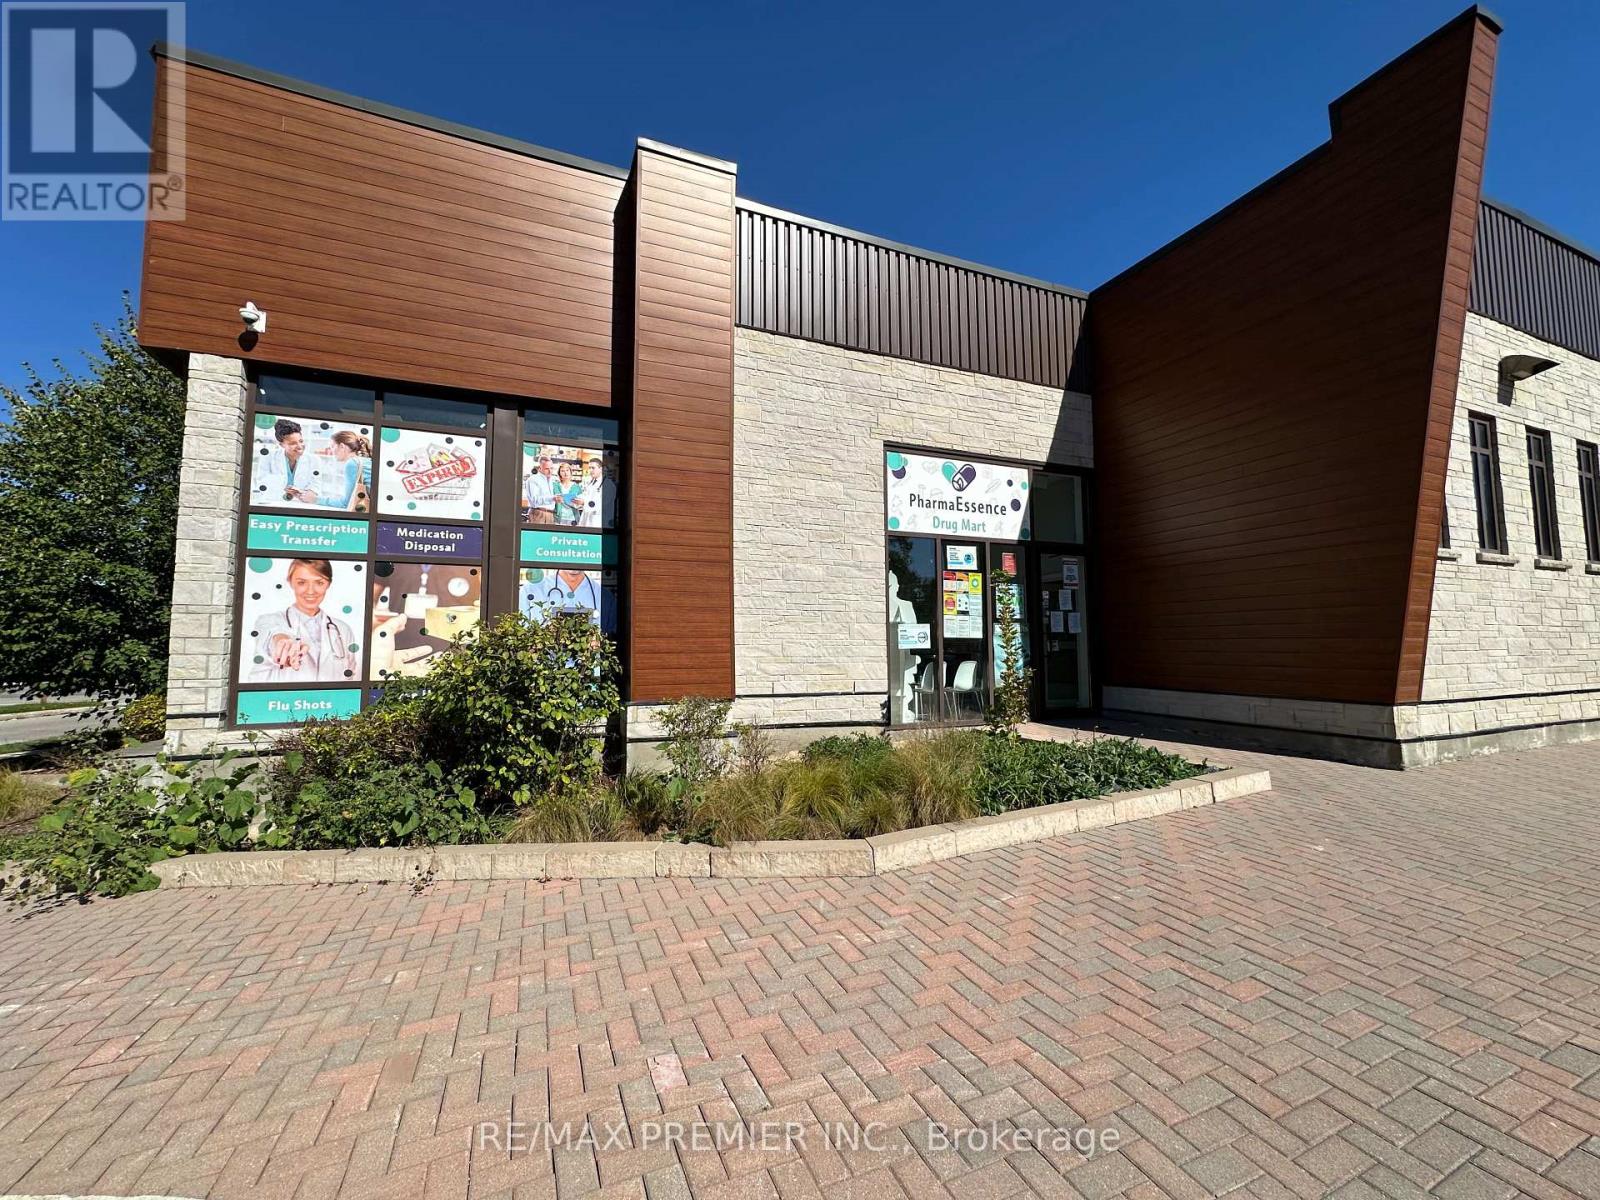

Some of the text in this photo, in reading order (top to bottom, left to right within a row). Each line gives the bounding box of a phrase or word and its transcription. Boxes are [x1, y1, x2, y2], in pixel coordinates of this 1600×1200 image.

[407, 458, 472, 490] EXPIRED
[909, 493, 1007, 516] PharmaEssence
[250, 519, 367, 535] Easy Prescription
[932, 515, 986, 533] Drug Mart
[397, 527, 464, 540] Medication
[281, 534, 337, 546] Transfer
[551, 536, 588, 546] Private
[405, 541, 456, 552] Disposal
[536, 547, 602, 558] Consultation
[268, 700, 332, 711] Flu Shots
